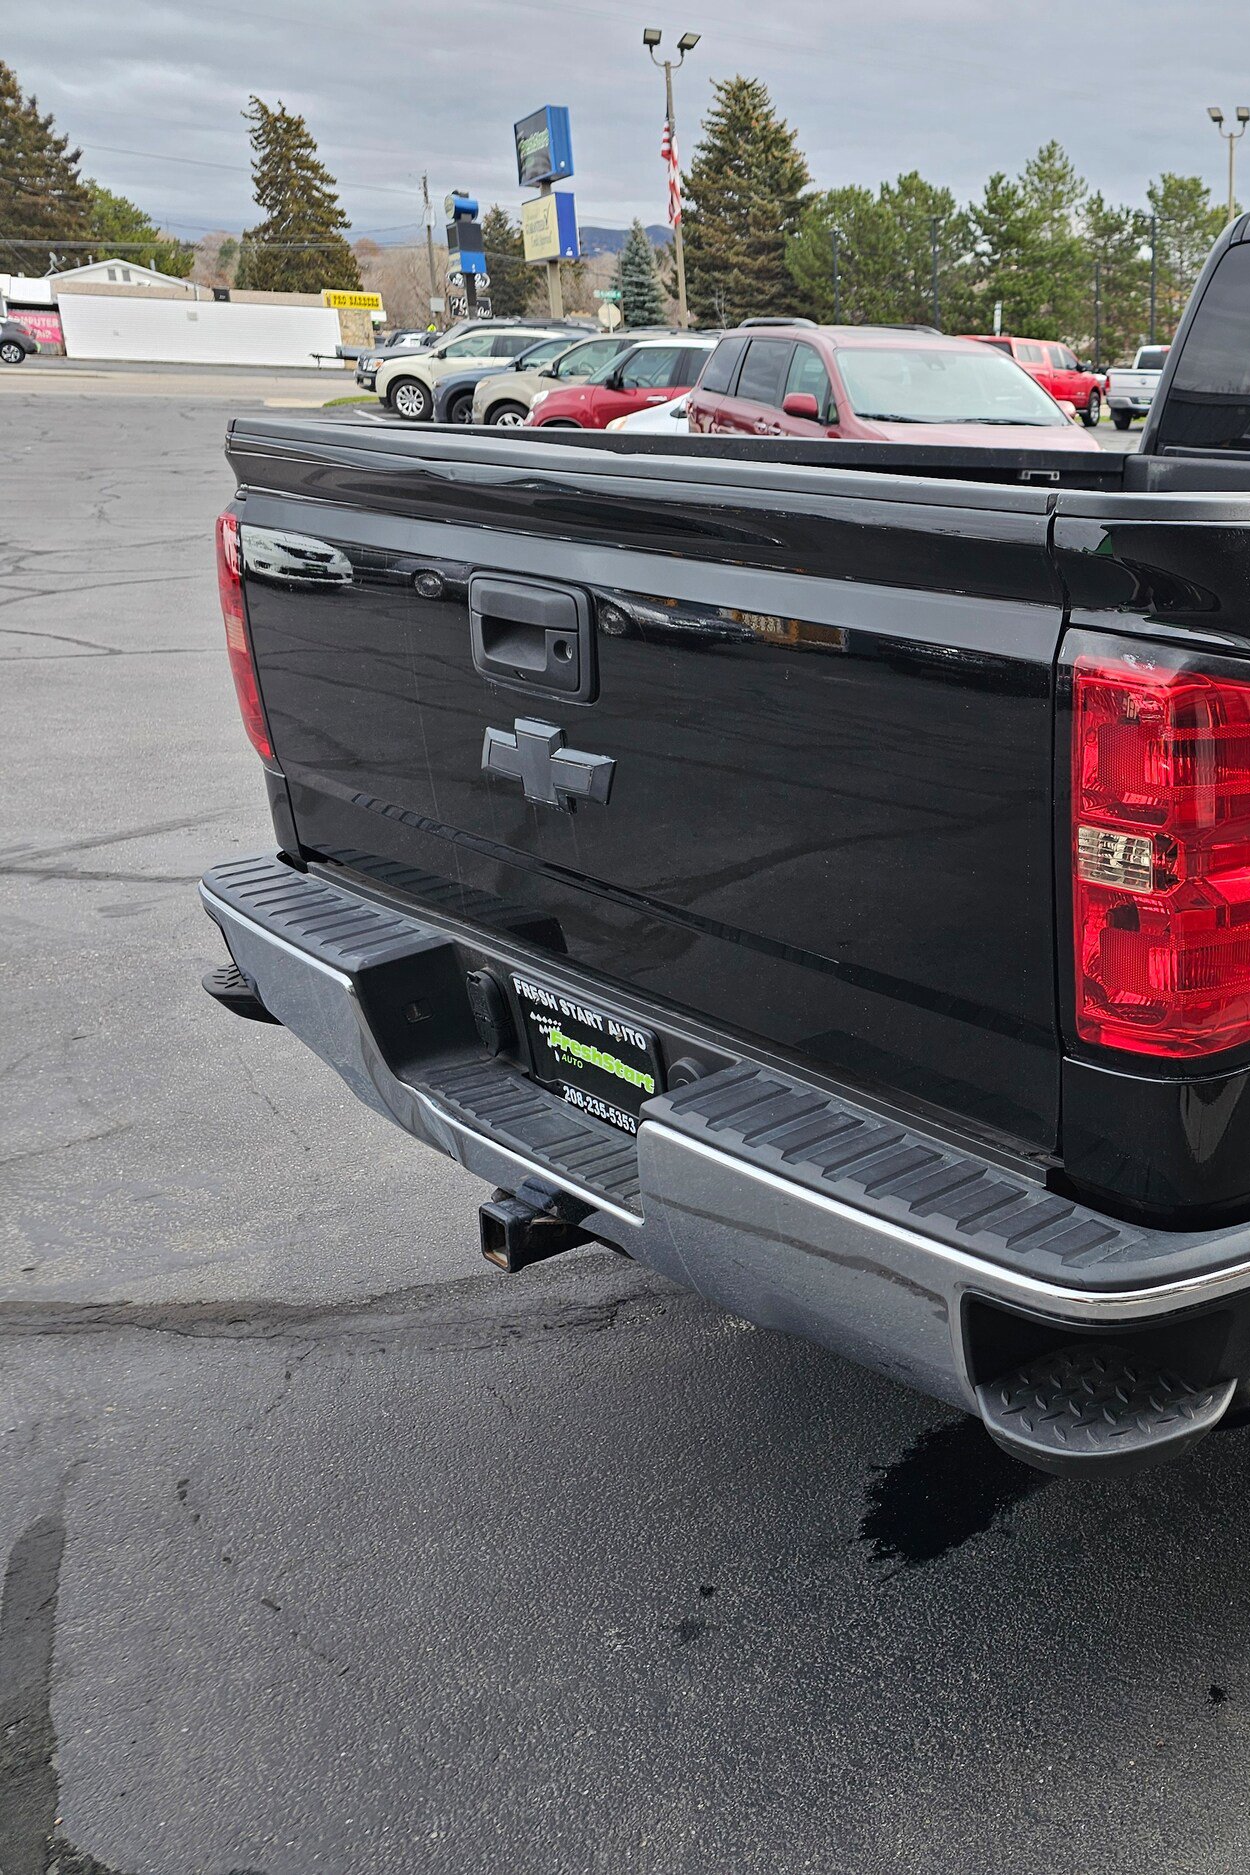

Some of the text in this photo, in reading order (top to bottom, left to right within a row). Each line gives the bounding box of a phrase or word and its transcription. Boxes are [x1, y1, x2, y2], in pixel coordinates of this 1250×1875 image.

[513, 978, 647, 1051] FRESH START AUTO
[550, 1029, 655, 1094] FreshStart
[561, 1054, 584, 1069] AUTO
[562, 1085, 637, 1135] 208-235-5353
